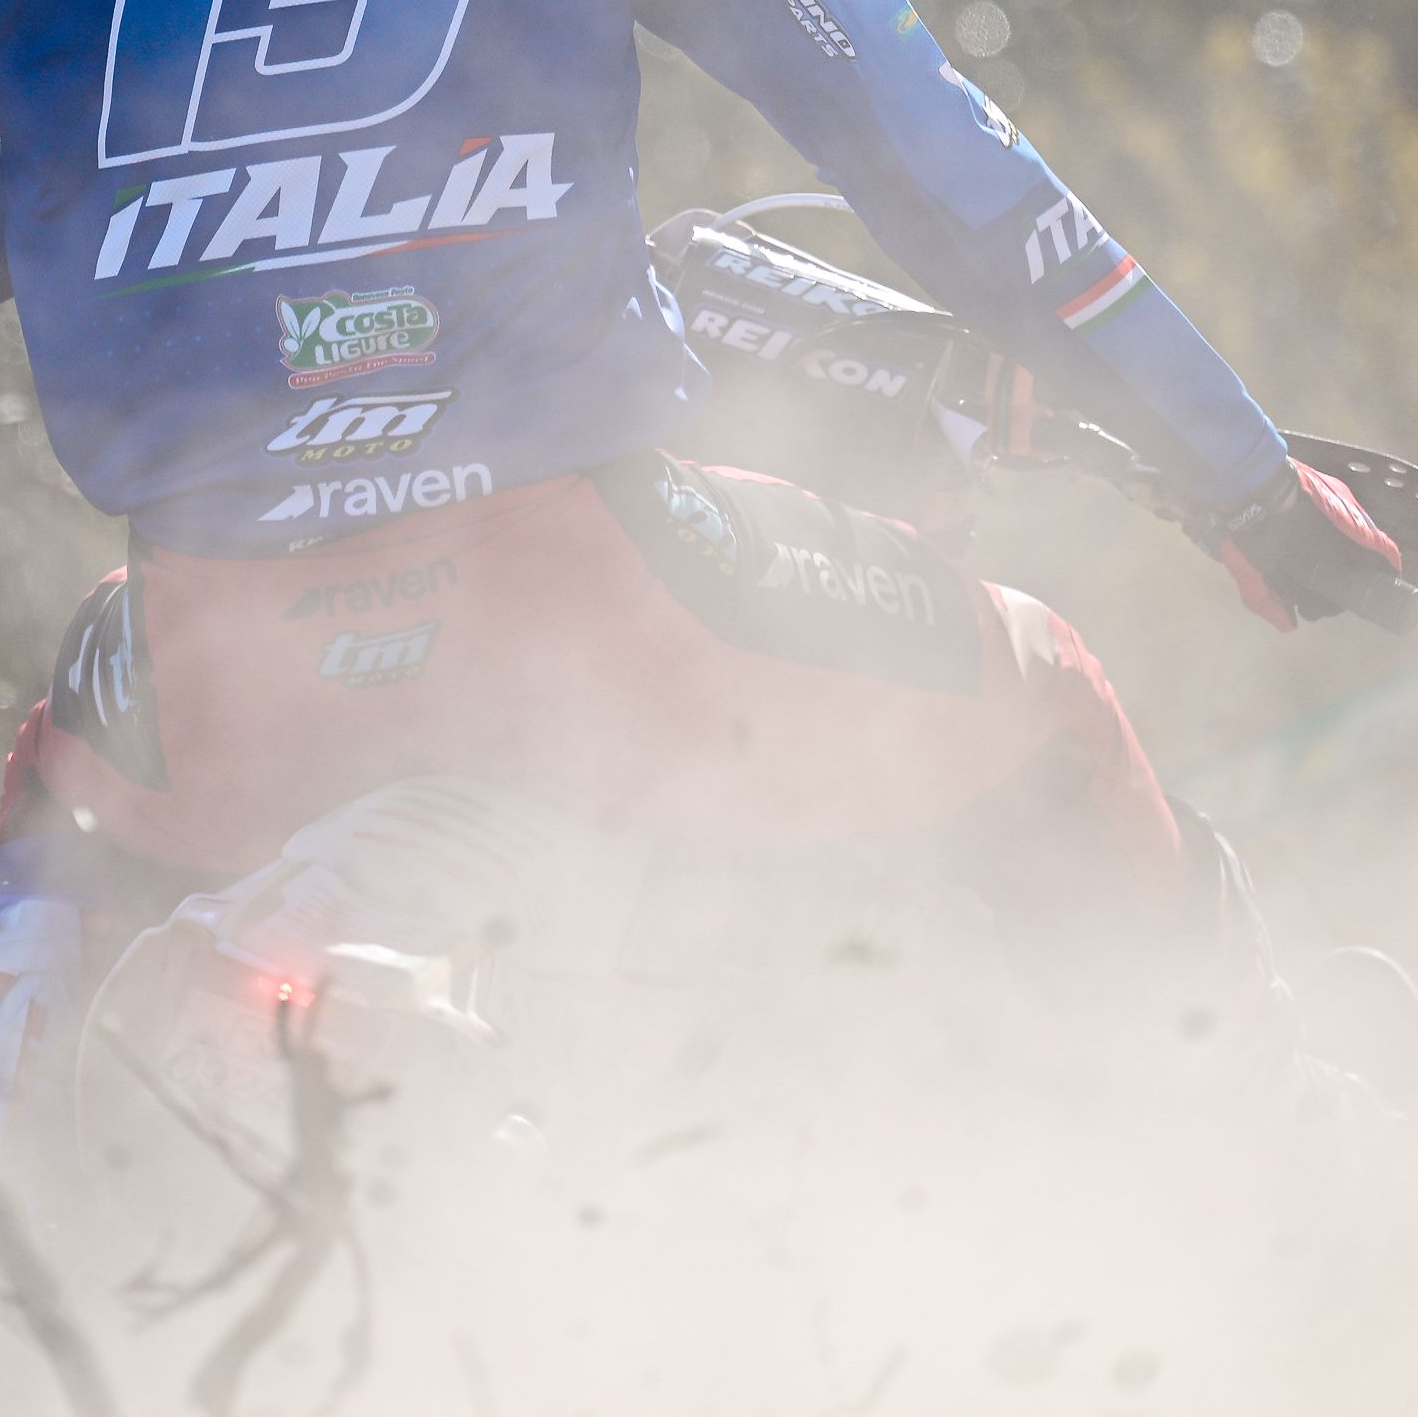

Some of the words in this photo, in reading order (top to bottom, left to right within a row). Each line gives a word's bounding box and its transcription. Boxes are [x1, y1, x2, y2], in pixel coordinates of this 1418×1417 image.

[94, 132, 574, 280] ITALIA
[300, 438, 414, 460] MOTO
[317, 462, 493, 518] raven
[324, 556, 459, 617] raven
[790, 545, 936, 627] raven
